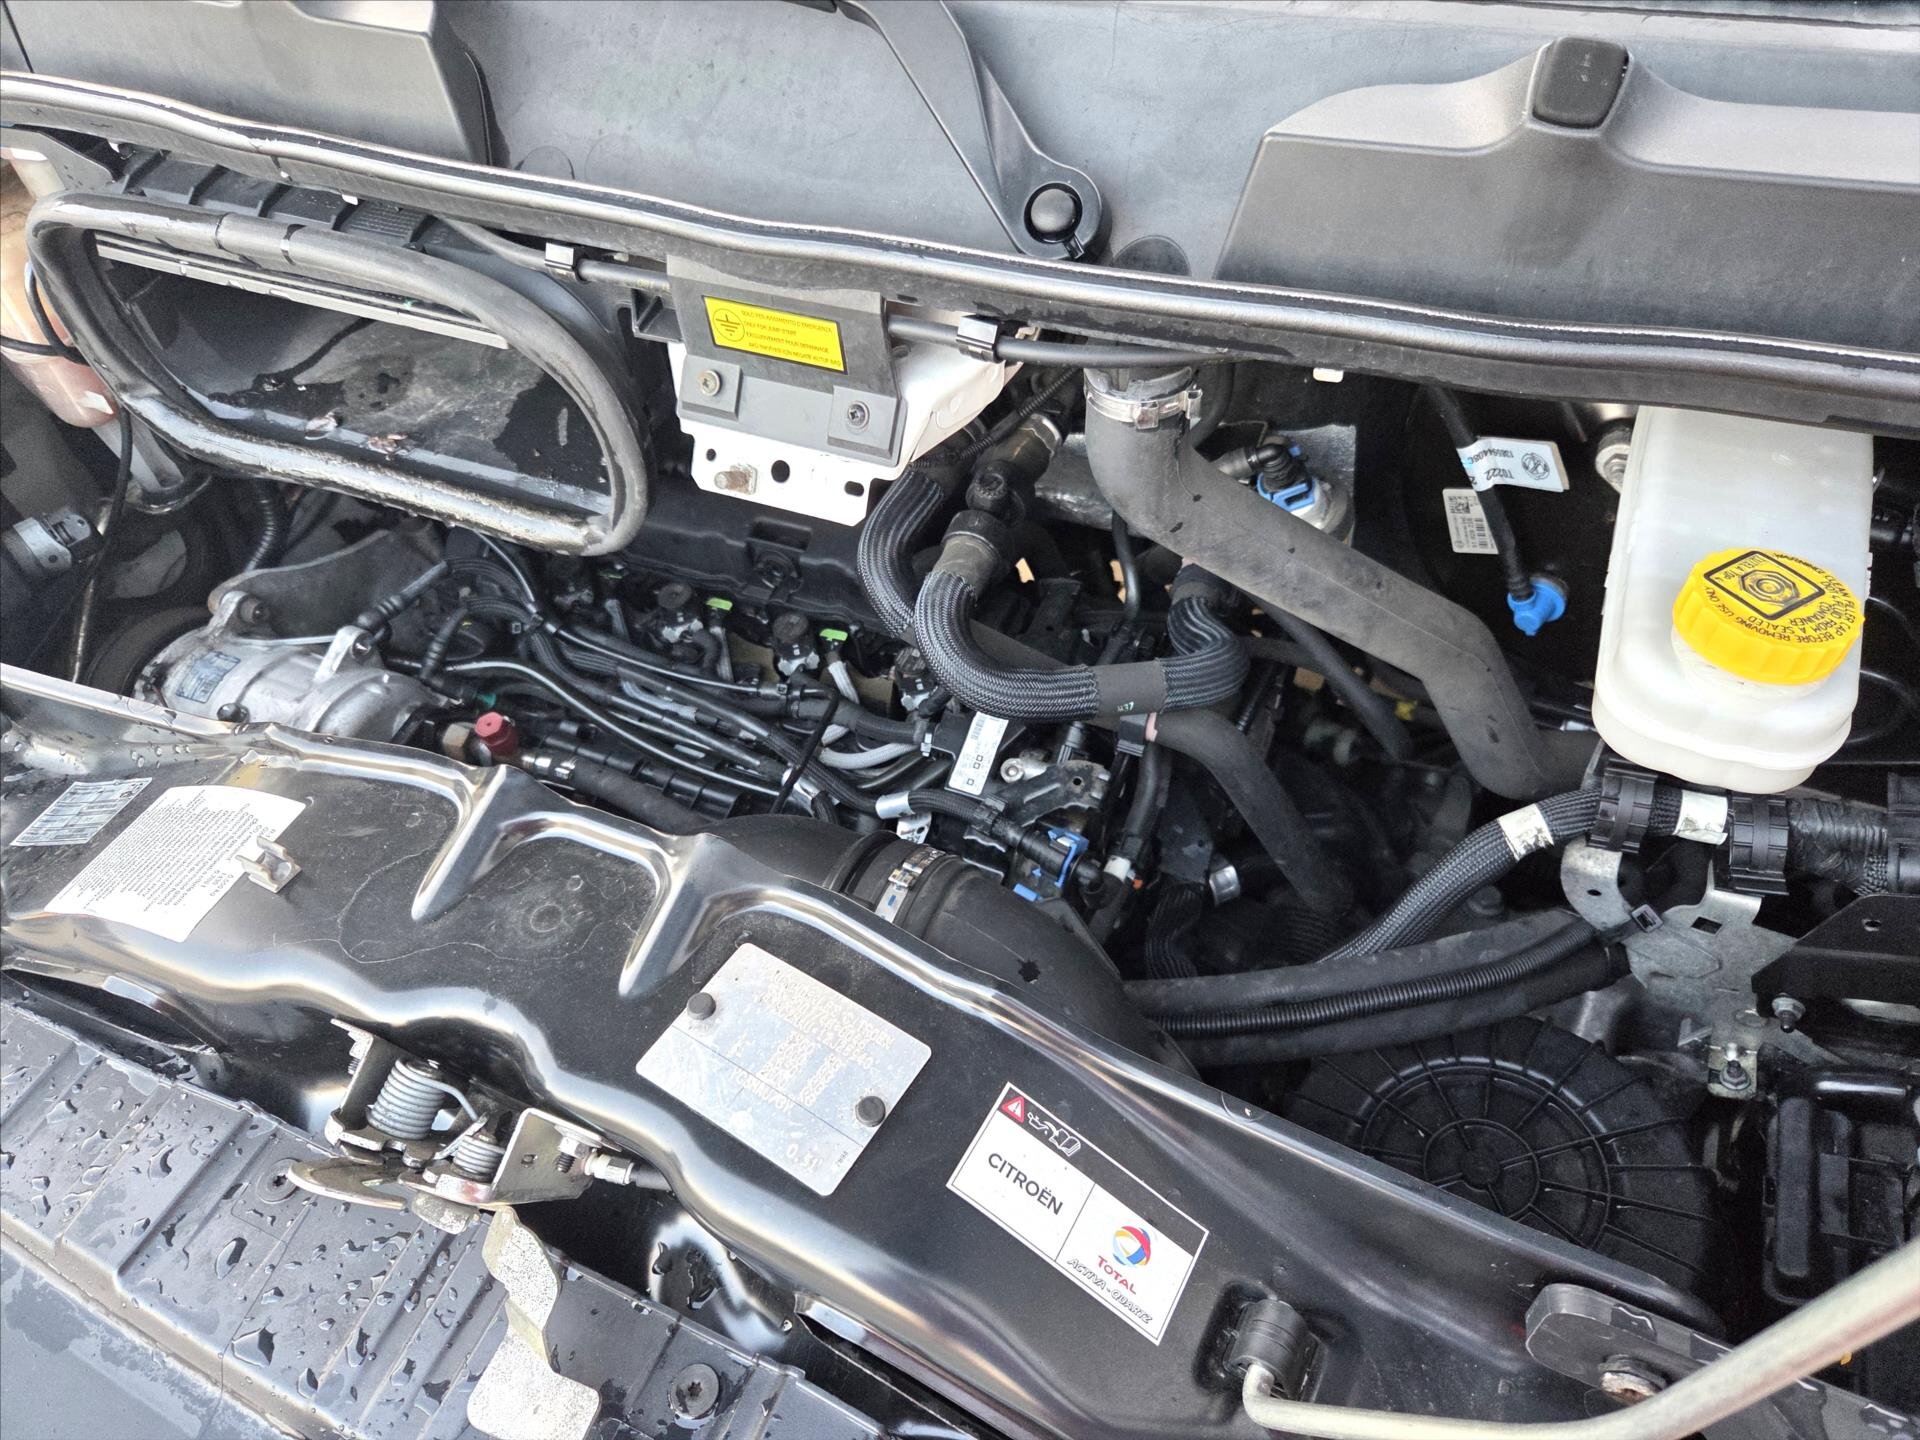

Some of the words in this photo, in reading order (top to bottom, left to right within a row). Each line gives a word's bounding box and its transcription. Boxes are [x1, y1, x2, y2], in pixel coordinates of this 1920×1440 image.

[1824, 575, 1849, 598] CLEAN
[1717, 604, 1735, 617] USE
[1790, 601, 1832, 627] CONTAINER
[1844, 599, 1856, 624] FILLER
[1735, 616, 1791, 642] REMOVING
[1748, 615, 1795, 635] SEALED
[1796, 630, 1835, 643] BEFORE
[1811, 619, 1837, 633] FROM
[987, 1152, 1064, 1216] CITROËN
[1098, 1255, 1137, 1296] TOTAL
[1067, 1256, 1107, 1291] ACTIVA
[1110, 1289, 1153, 1325] QUARTZ
